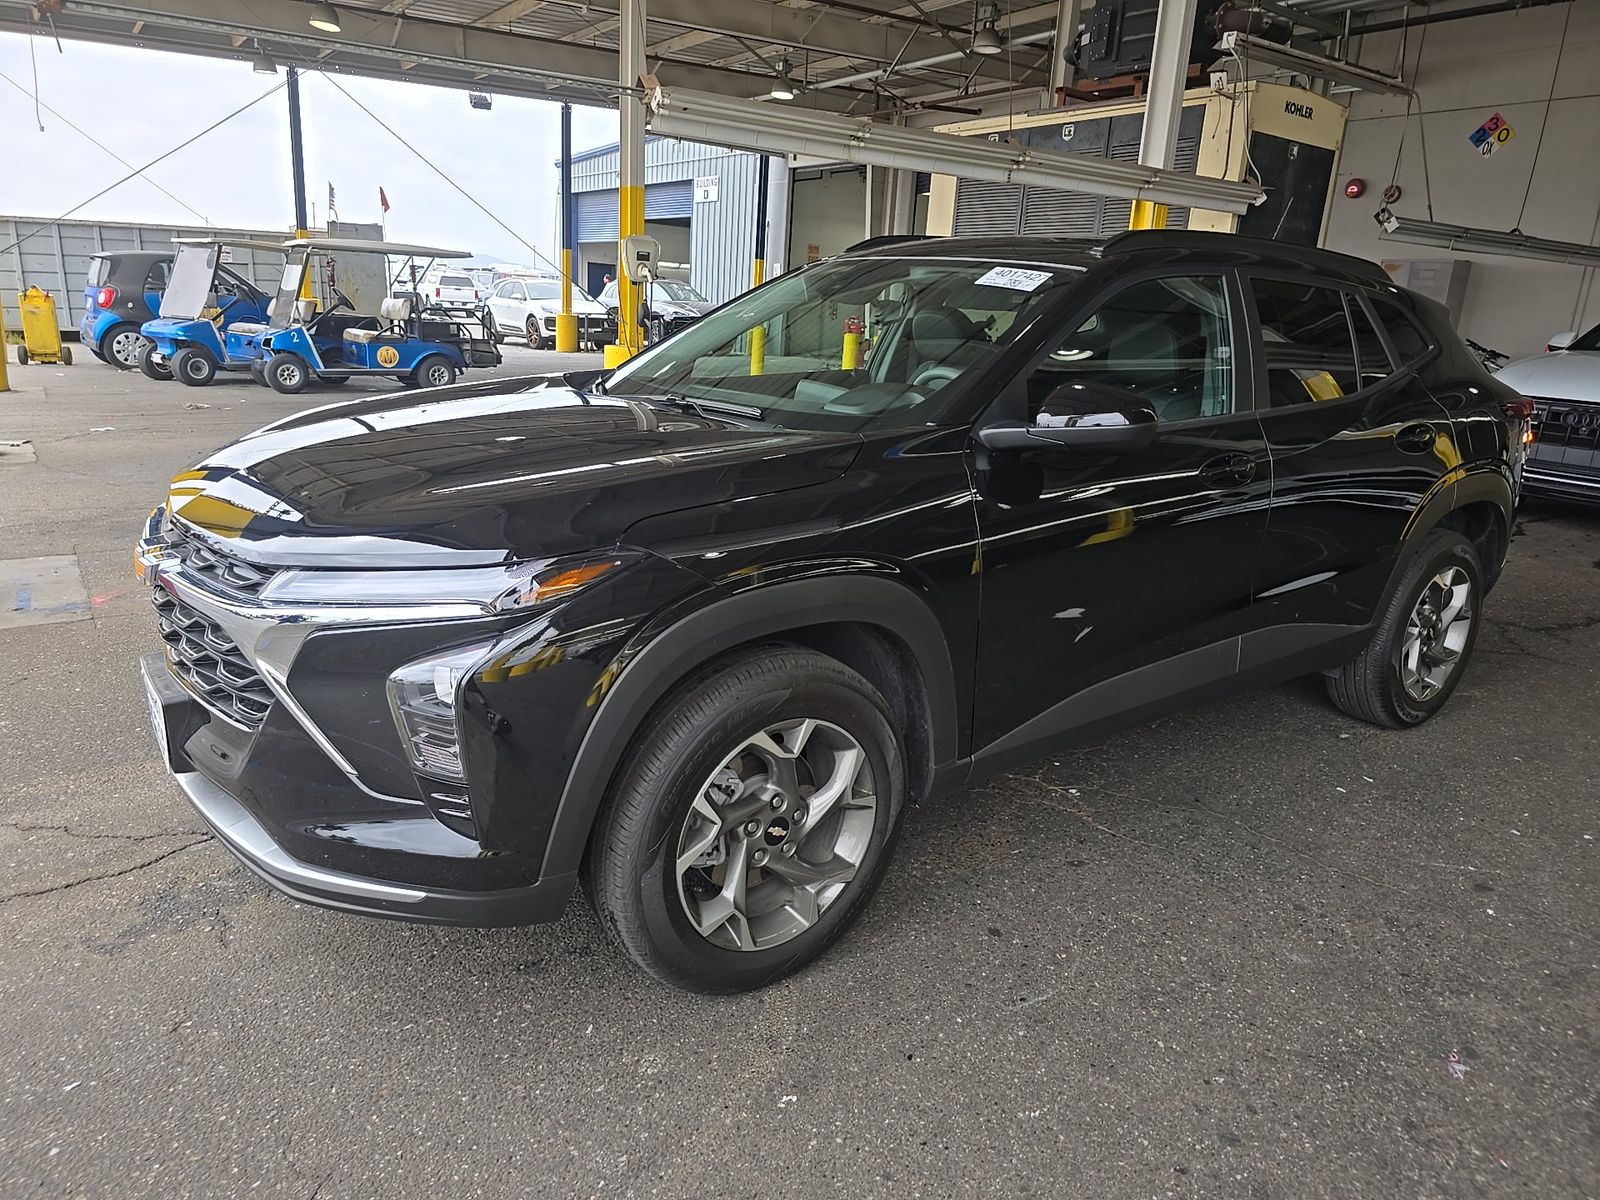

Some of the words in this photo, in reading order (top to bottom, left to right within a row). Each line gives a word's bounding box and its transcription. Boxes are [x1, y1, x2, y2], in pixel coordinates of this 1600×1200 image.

[1284, 100, 1314, 120] KOHLER
[1488, 117, 1499, 131] 3
[696, 177, 718, 188] BUILDING
[703, 189, 709, 200] D
[290, 331, 300, 343] 2
